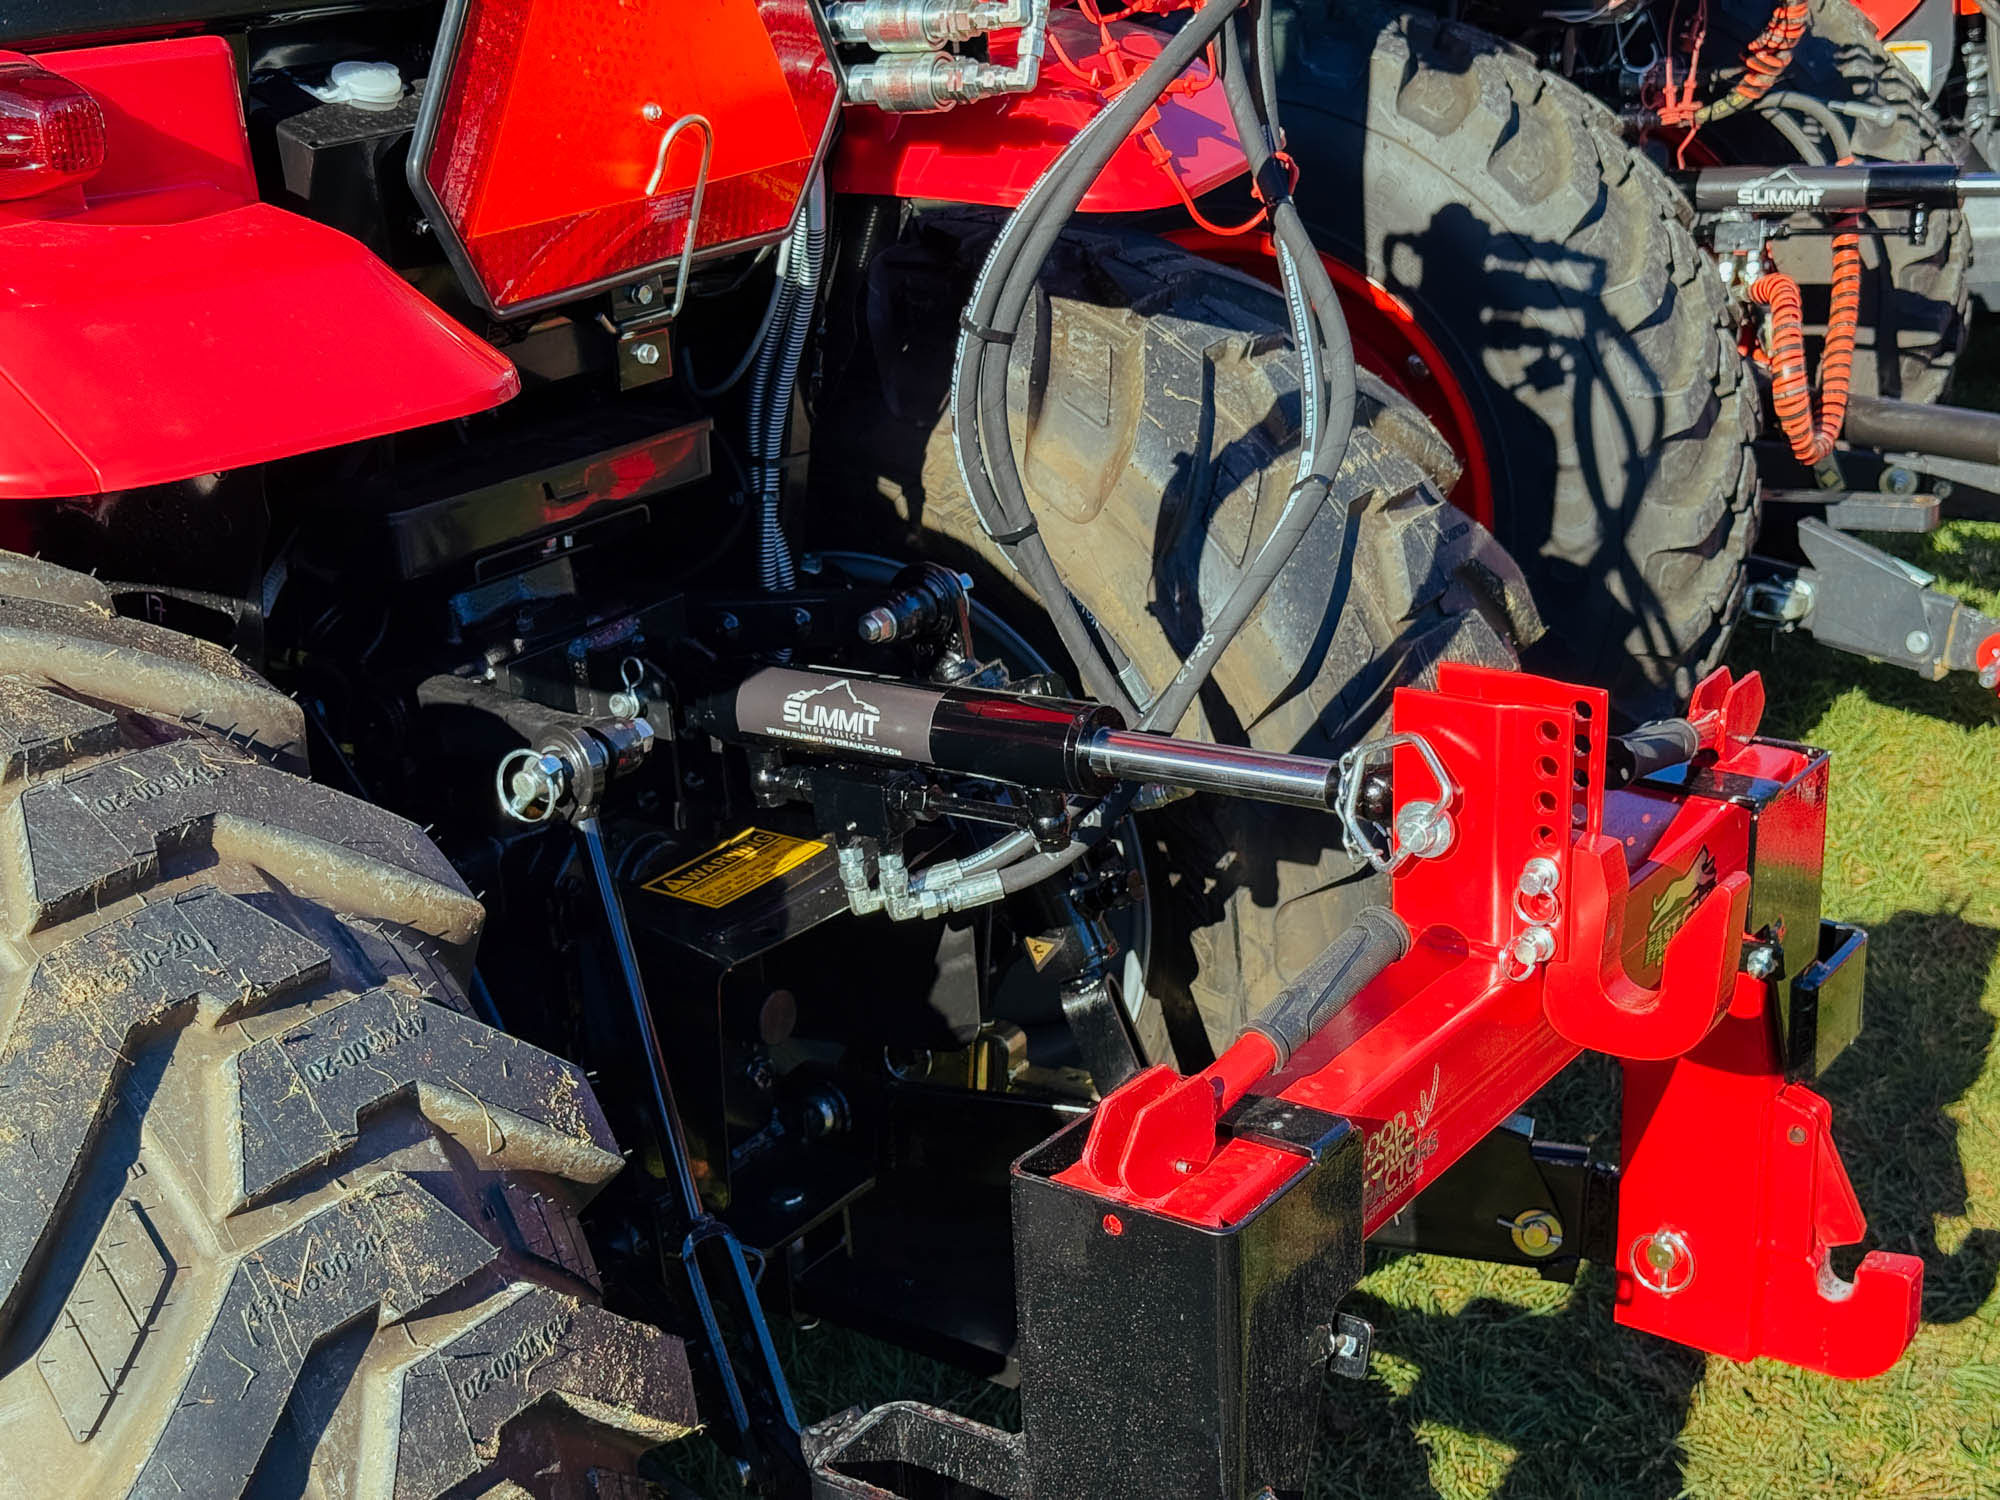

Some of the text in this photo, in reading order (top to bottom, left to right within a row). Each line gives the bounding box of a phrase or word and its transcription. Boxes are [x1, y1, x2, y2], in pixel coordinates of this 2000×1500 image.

[1737, 188, 1825, 206] SUMMIT
[782, 700, 881, 736] SUMMIT
[800, 724, 863, 742] HYDRAULICS
[765, 727, 902, 757] WWW.SUMMIT-HYDRAULICS.COM
[685, 832, 775, 884] WARNING
[1364, 1110, 1407, 1157] OOD
[1364, 1126, 1415, 1181] ORKS
